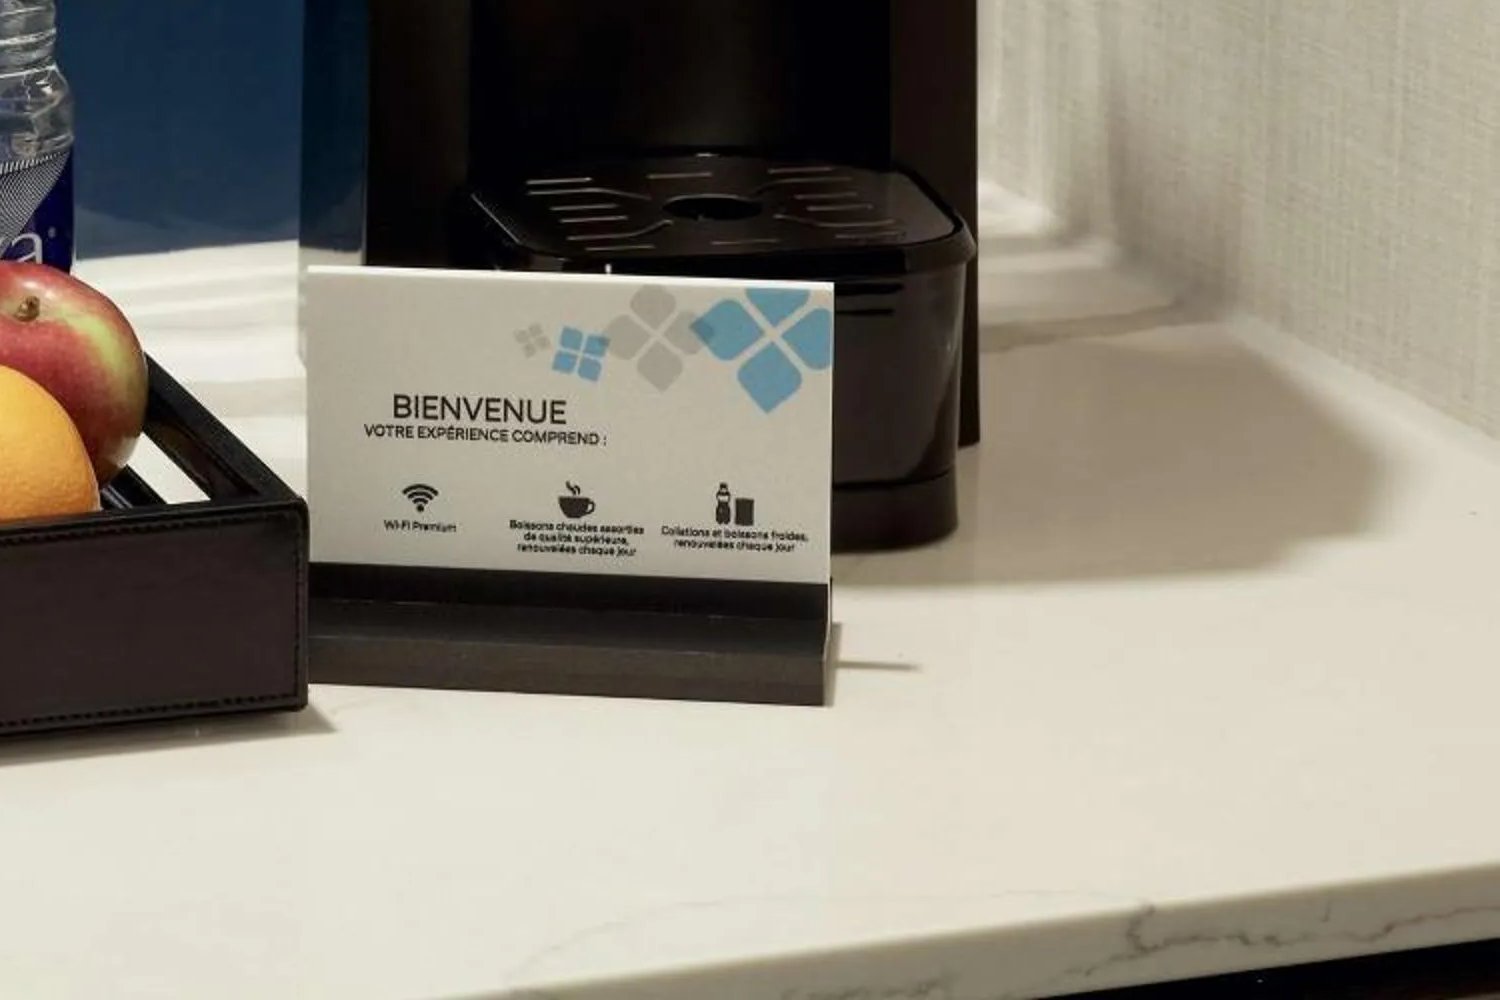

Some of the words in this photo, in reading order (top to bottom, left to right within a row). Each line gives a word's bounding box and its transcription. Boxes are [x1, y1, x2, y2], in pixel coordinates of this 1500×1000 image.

[393, 393, 568, 426] BIENVENUE
[364, 424, 414, 439] VOTRE
[417, 424, 509, 443] EXPÉRIENCE
[511, 429, 599, 446] COMPREND
[412, 521, 458, 533] Premium
[509, 519, 554, 531] Boissons
[556, 522, 598, 533] chaudes
[600, 524, 645, 535] assorties
[661, 525, 710, 538] Collations
[724, 530, 769, 540] boissons
[524, 532, 537, 541] de
[539, 533, 573, 545] qualité
[579, 545, 615, 556] chaque
[616, 548, 637, 557] jour
[737, 541, 773, 552] chaque
[775, 543, 795, 553] jour
